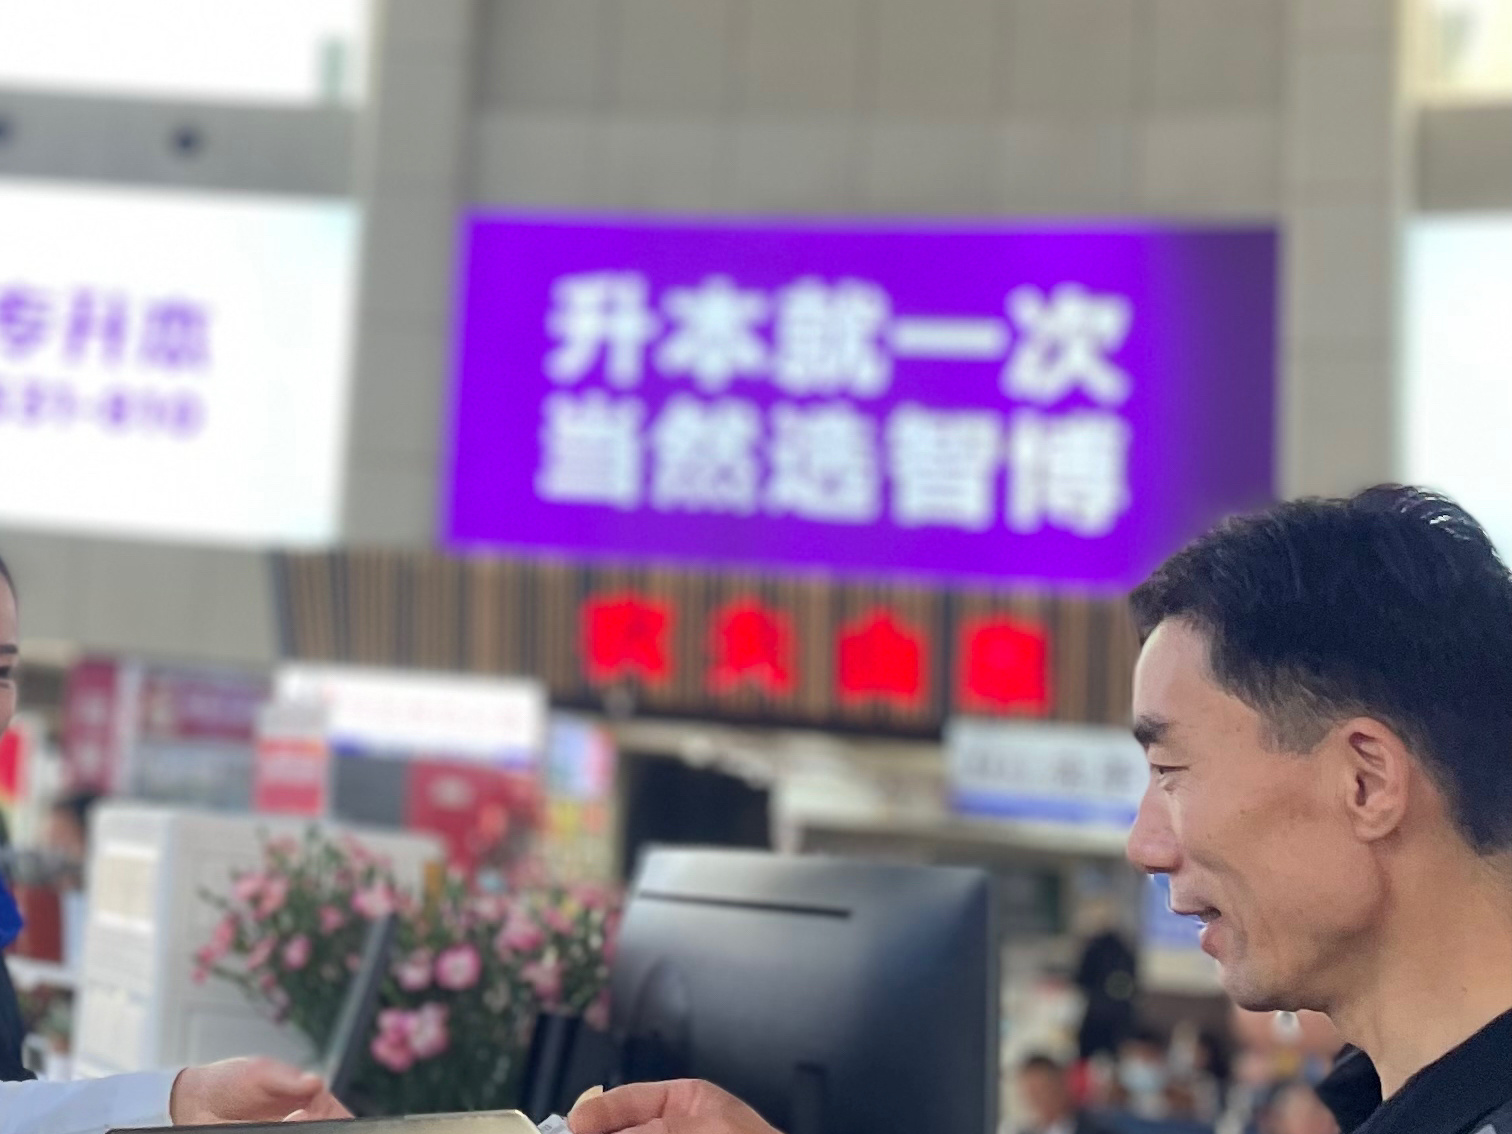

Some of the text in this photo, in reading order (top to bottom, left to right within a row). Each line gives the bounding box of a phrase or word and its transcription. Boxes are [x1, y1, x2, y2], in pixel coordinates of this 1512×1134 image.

[542, 271, 1133, 404] 升本就一次
[534, 390, 1130, 537] 当然选智博
